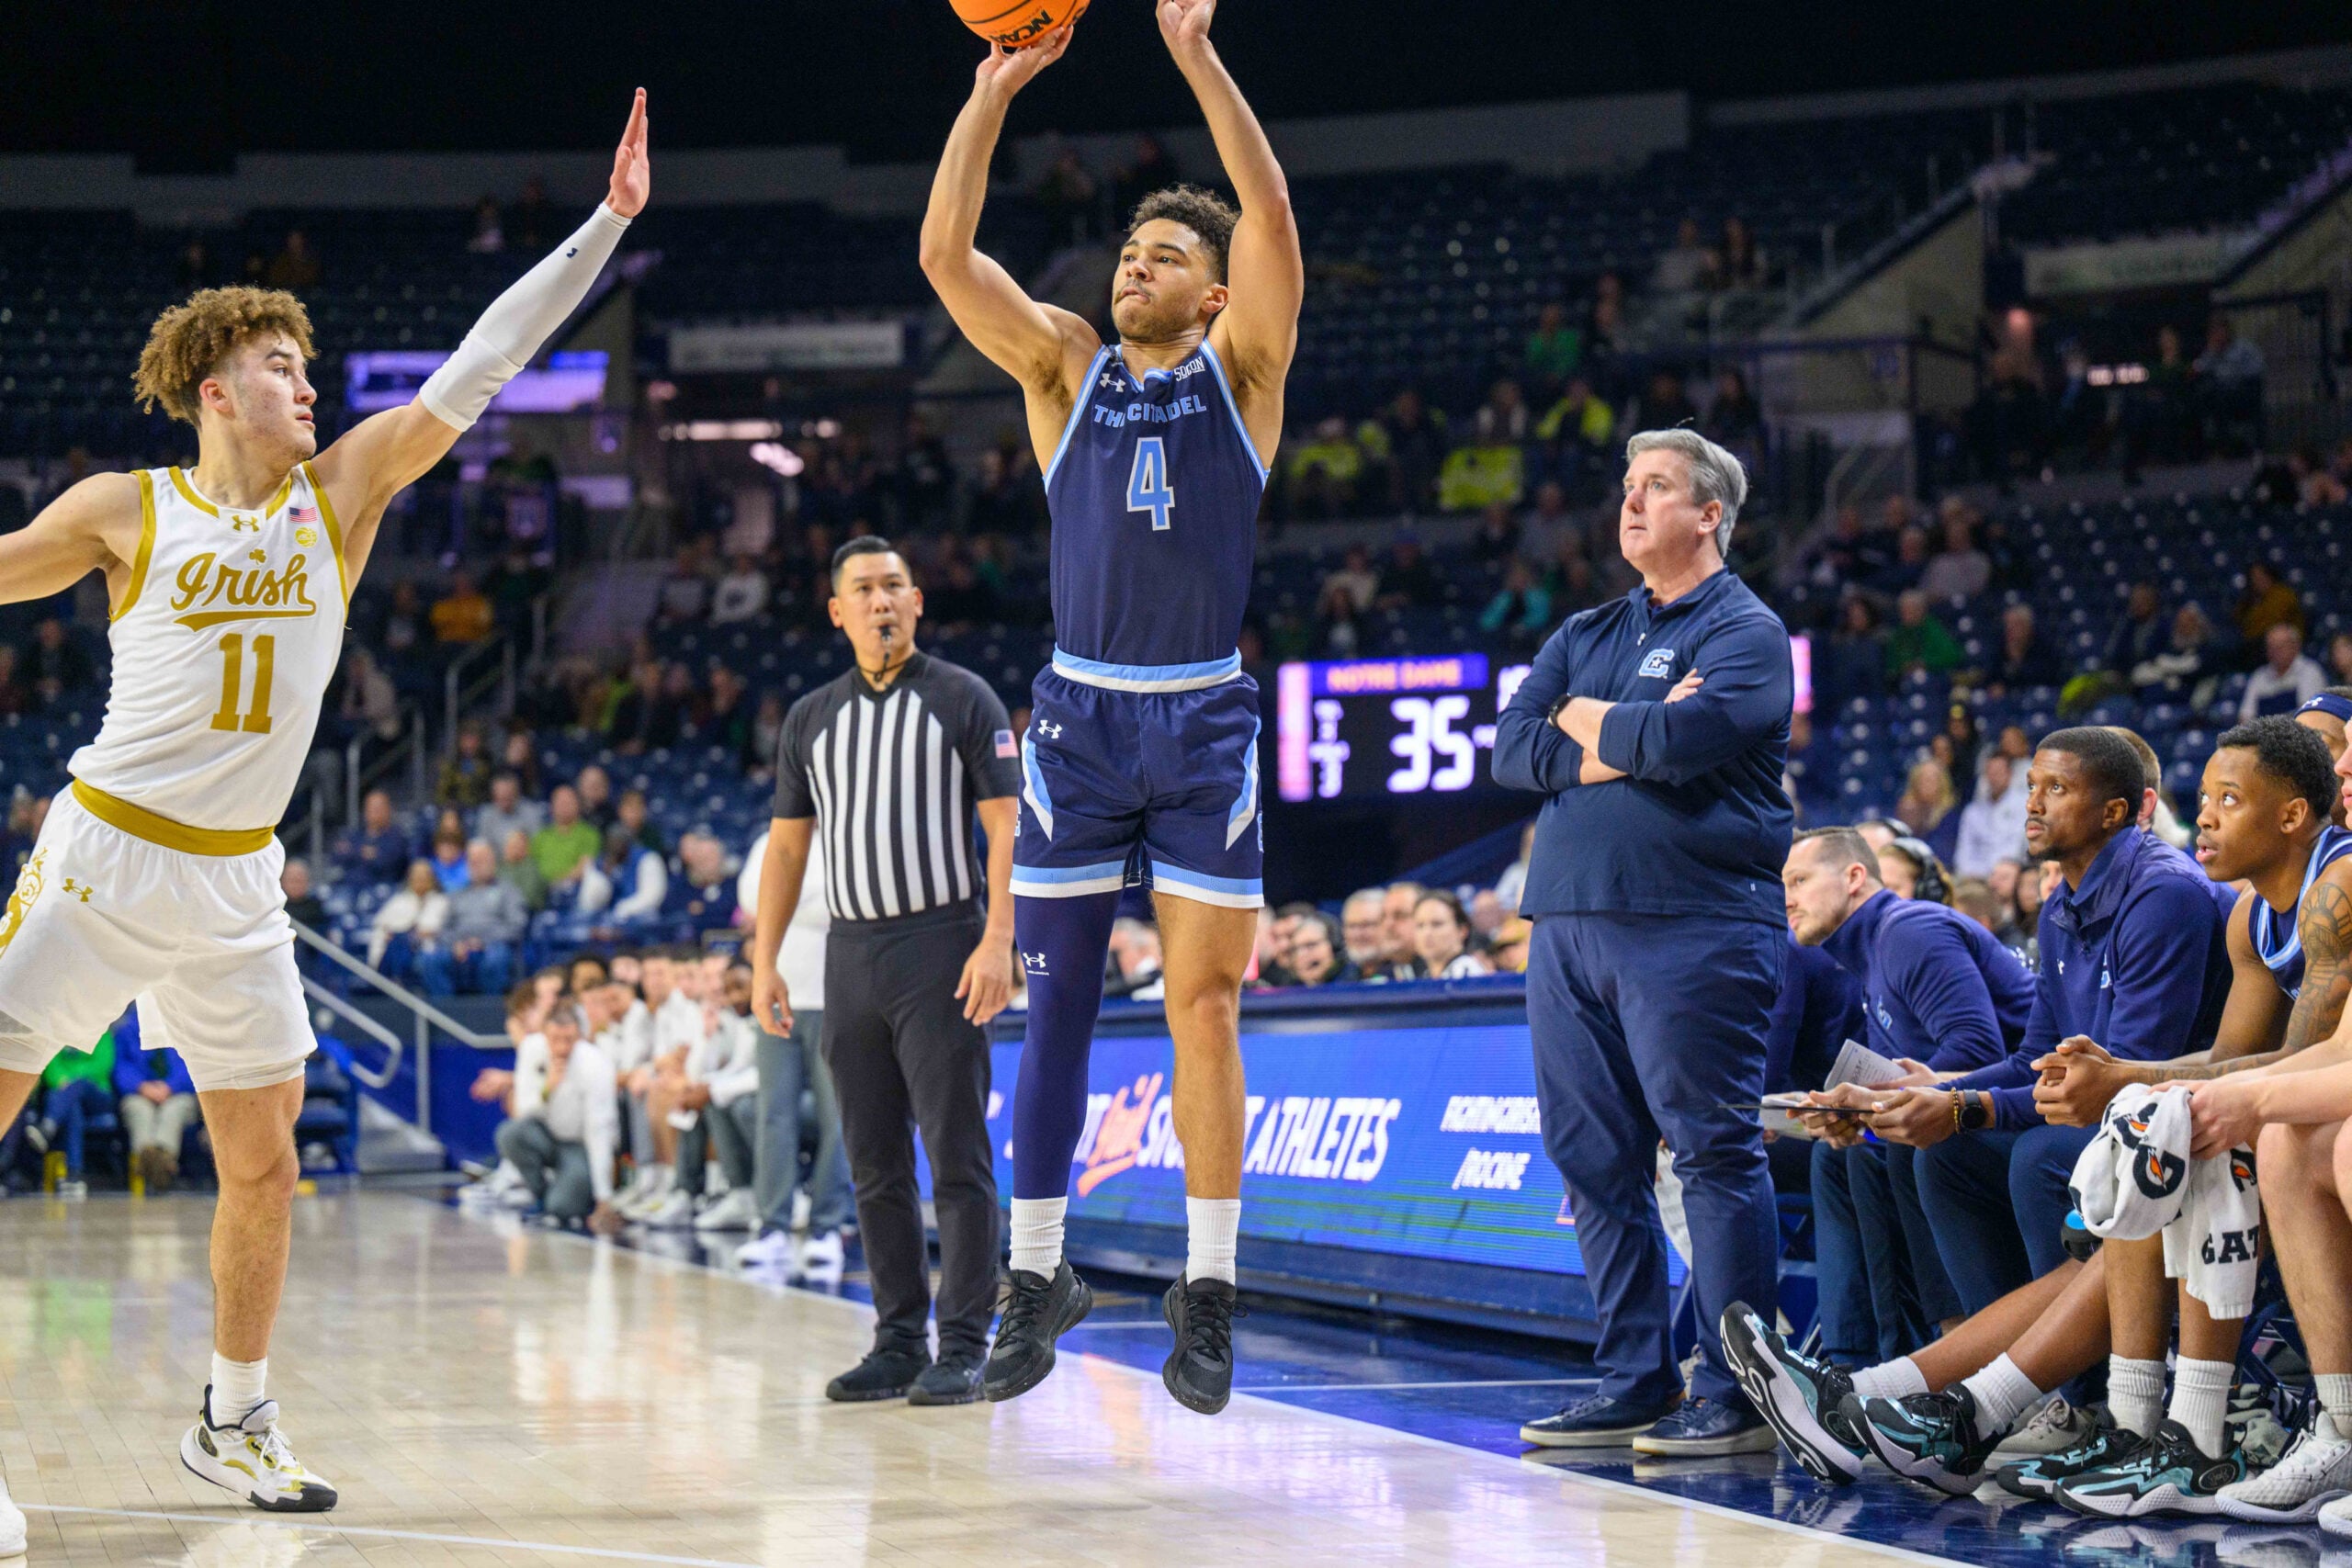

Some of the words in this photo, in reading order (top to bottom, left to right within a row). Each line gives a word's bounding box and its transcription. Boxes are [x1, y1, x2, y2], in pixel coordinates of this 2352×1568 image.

[989, 9, 1054, 44] NCAA
[1173, 355, 1206, 382] SOCON
[1126, 436, 1175, 532] 4
[170, 550, 317, 620] Irish
[209, 632, 276, 735] 11
[1385, 694, 1476, 794] 35
[1242, 1095, 1403, 1182] ATHLETES
